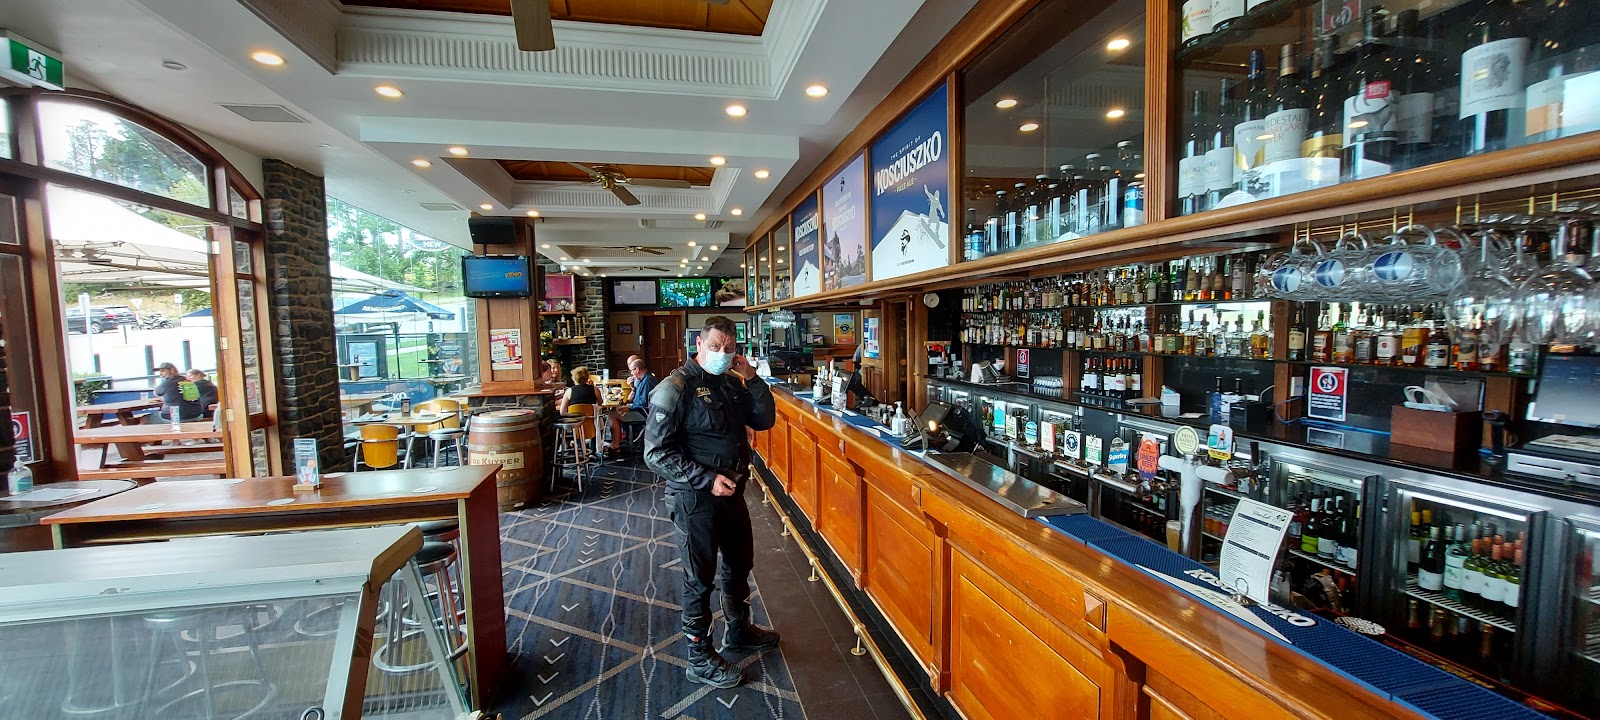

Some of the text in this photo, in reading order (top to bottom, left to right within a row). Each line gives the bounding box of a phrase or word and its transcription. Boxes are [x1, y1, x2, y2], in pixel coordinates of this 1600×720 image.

[899, 141, 913, 155] SPIRIT
[876, 130, 942, 197] KOSCIUSZKO
[422, 240, 442, 248] NEW
